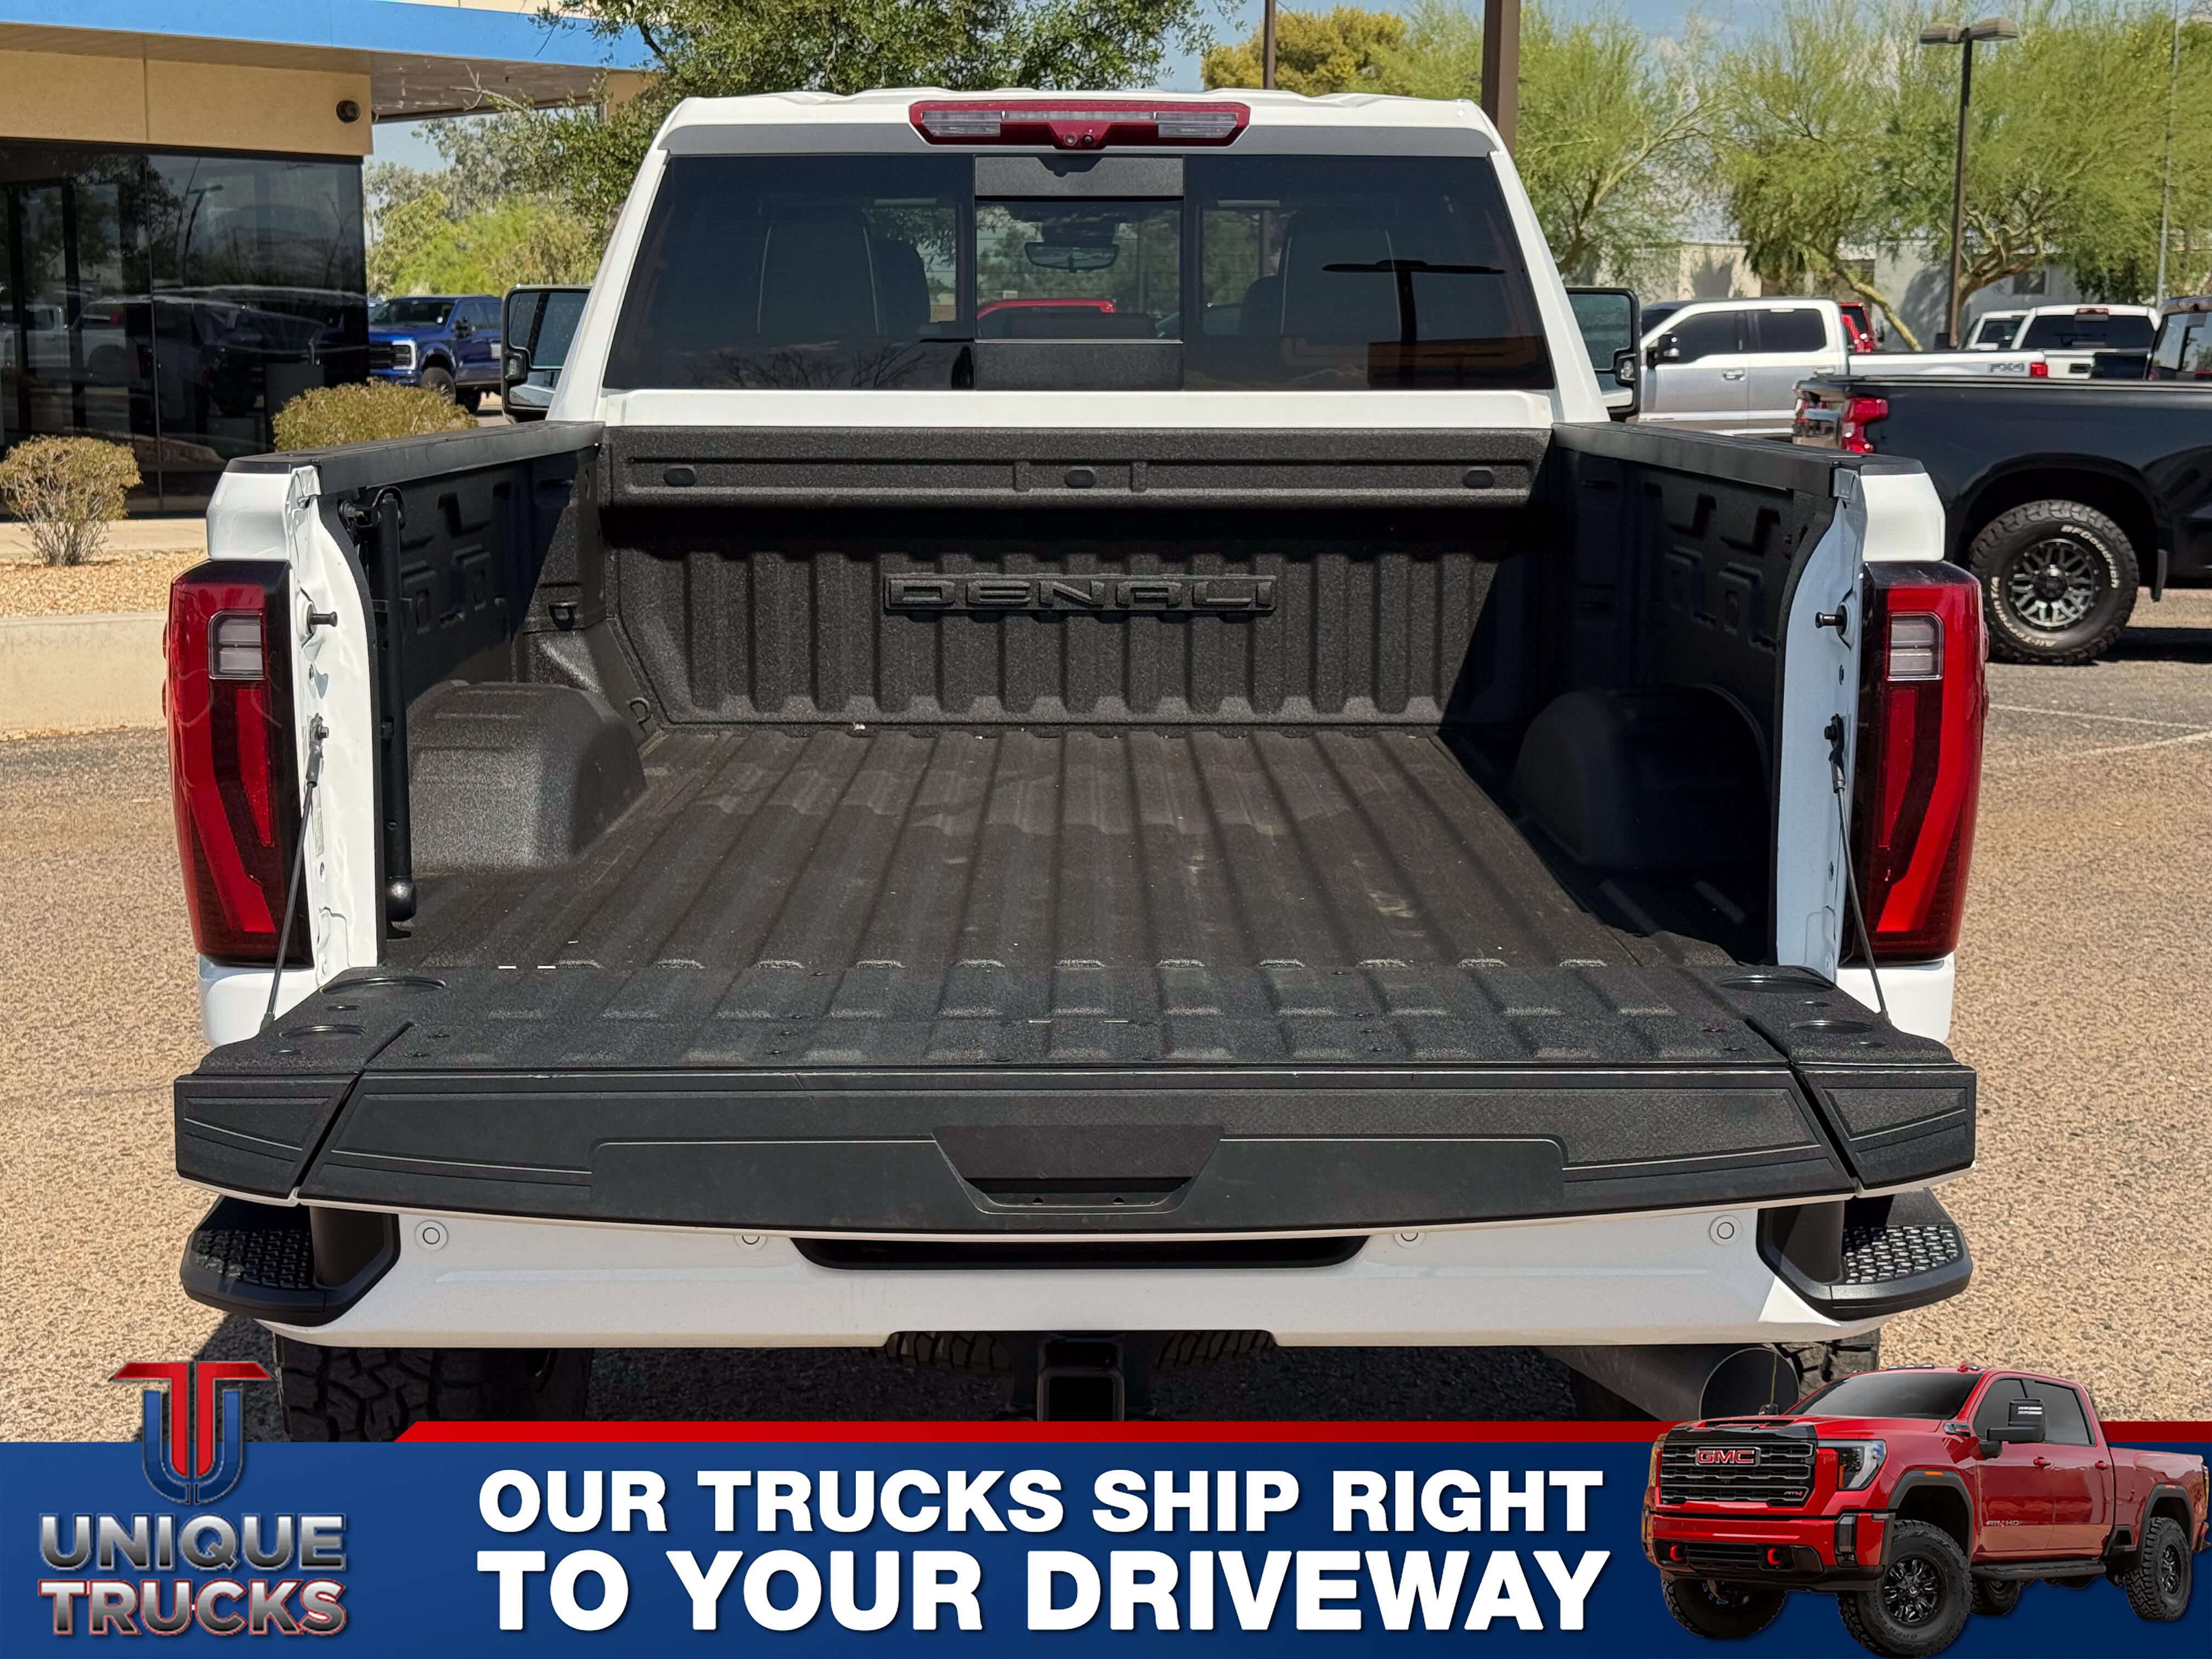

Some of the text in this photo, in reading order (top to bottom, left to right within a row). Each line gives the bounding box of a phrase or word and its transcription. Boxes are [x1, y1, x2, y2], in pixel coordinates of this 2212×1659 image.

[1988, 363, 2025, 373] FX4
[2060, 524, 2120, 589] BFGoodrich
[888, 579, 1273, 607] DENALI
